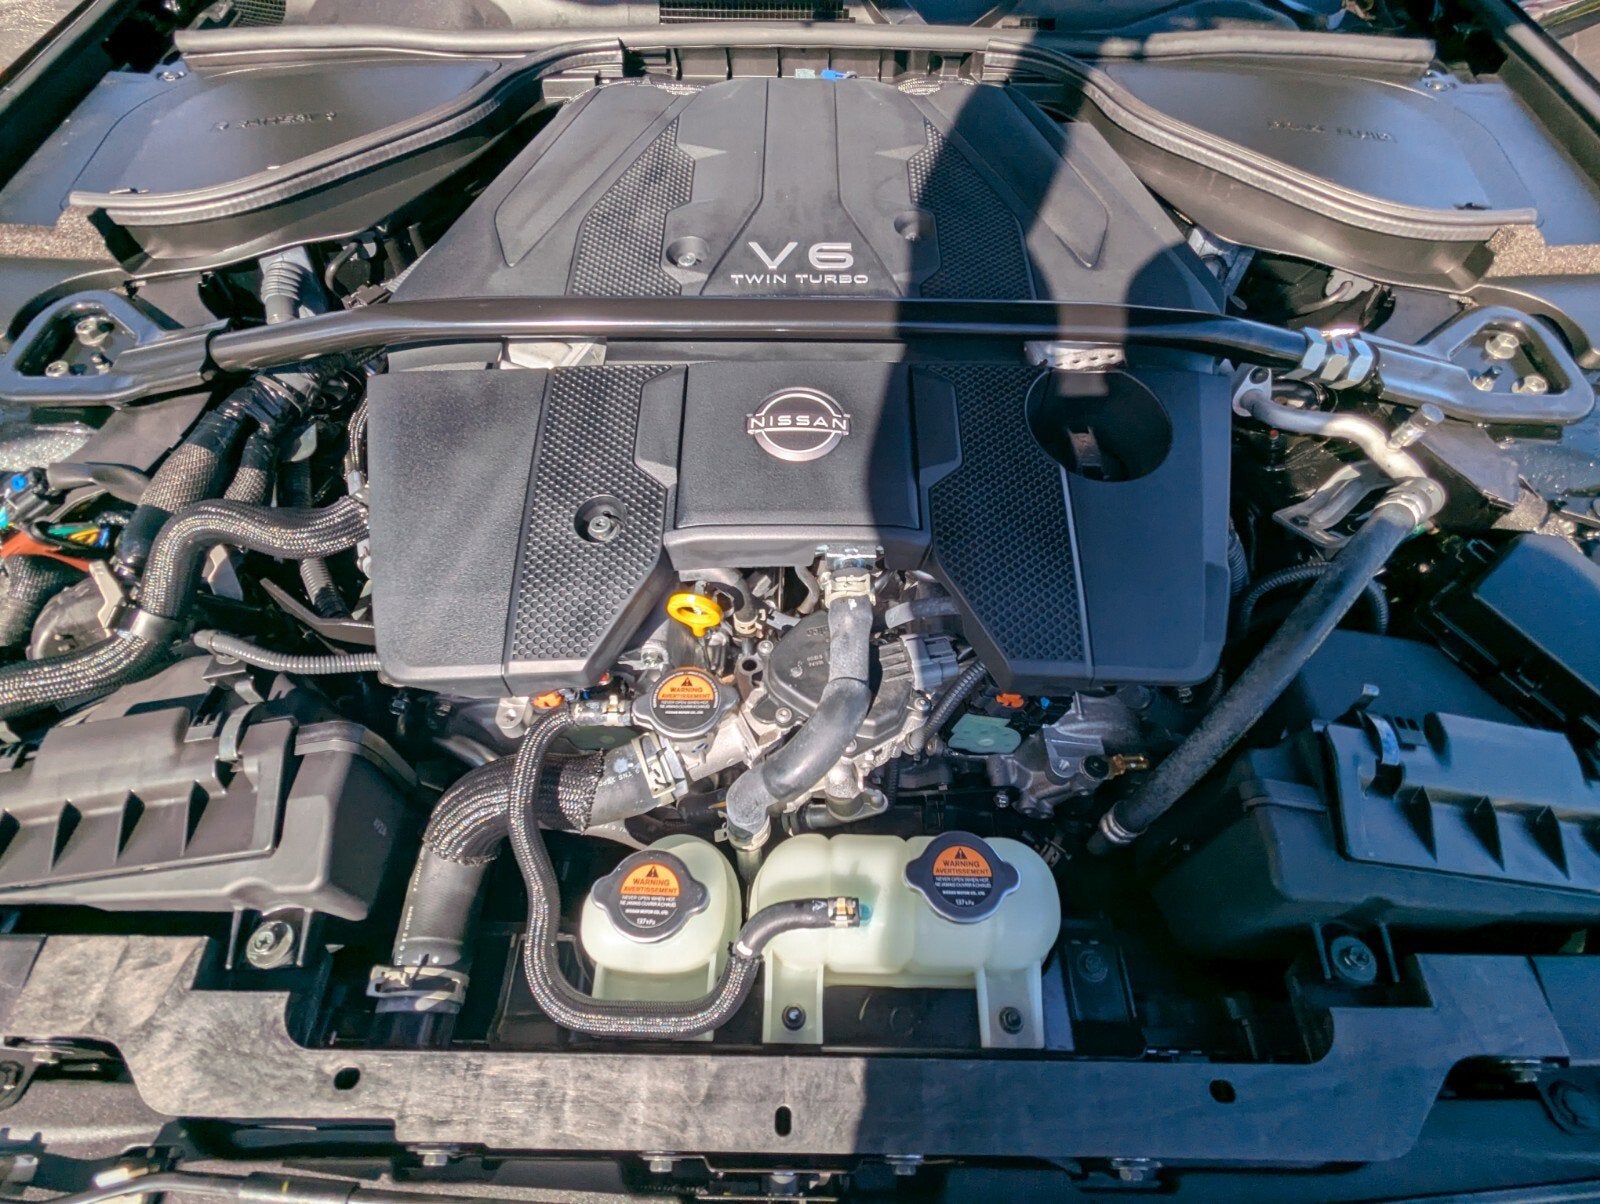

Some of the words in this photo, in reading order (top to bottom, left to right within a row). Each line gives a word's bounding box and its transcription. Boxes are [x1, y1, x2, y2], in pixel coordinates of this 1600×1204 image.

[747, 241, 854, 269] V6
[731, 274, 787, 284] TWIN
[795, 274, 869, 284] TURBO
[750, 415, 842, 430] NISSAN
[943, 860, 980, 868] WARNING
[633, 878, 670, 886] WARNING
[624, 886, 677, 894] AVERTISSEMENT
